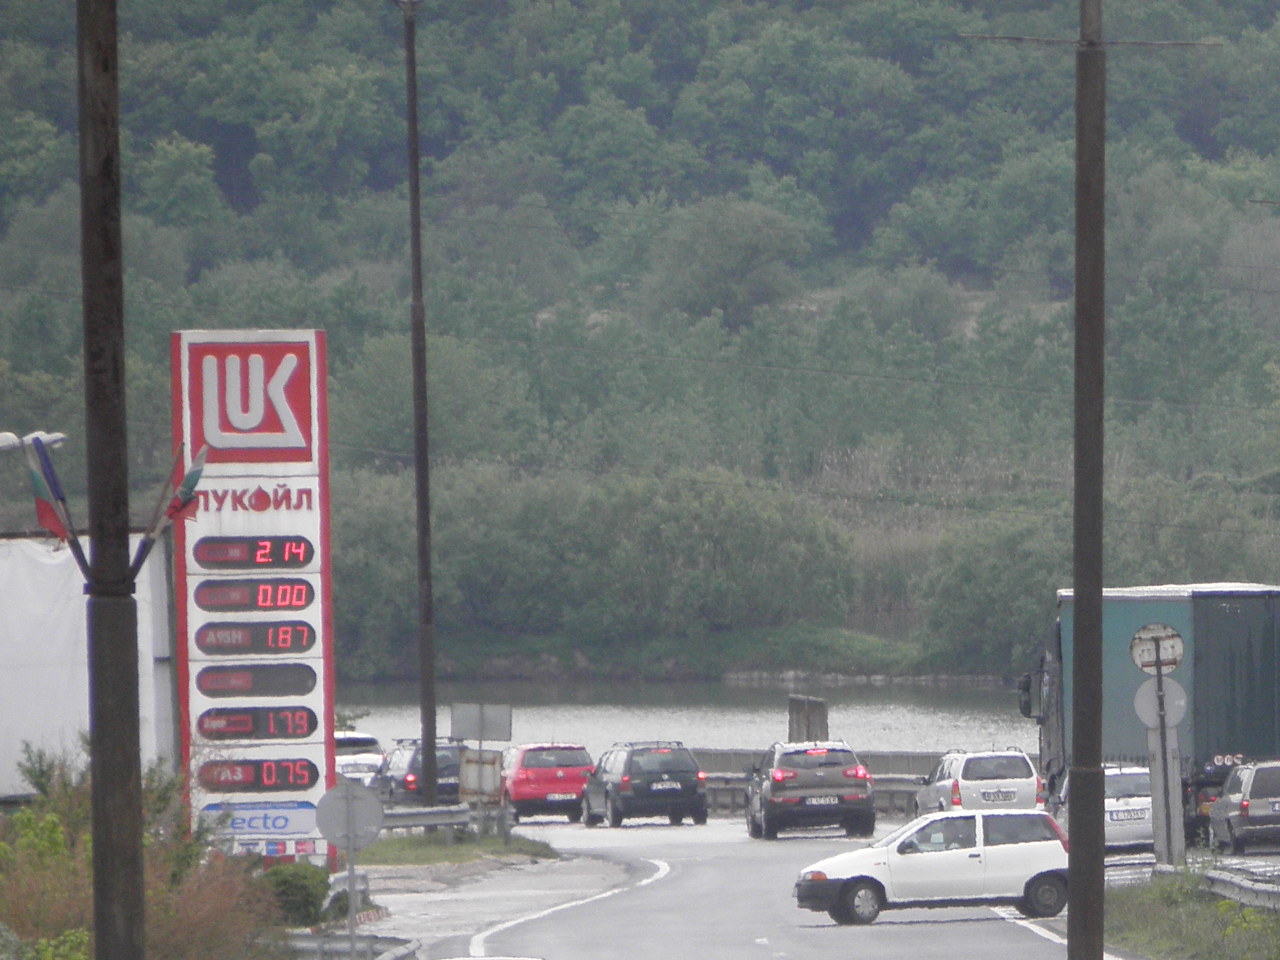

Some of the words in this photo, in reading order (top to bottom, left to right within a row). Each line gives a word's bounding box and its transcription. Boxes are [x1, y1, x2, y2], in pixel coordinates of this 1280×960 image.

[255, 541, 306, 563] 2.14
[257, 584, 307, 607] 0.00
[267, 626, 309, 649] 1.87
[268, 711, 309, 735] 1.79
[262, 761, 310, 787] 0.75
[230, 813, 289, 830] ecto
